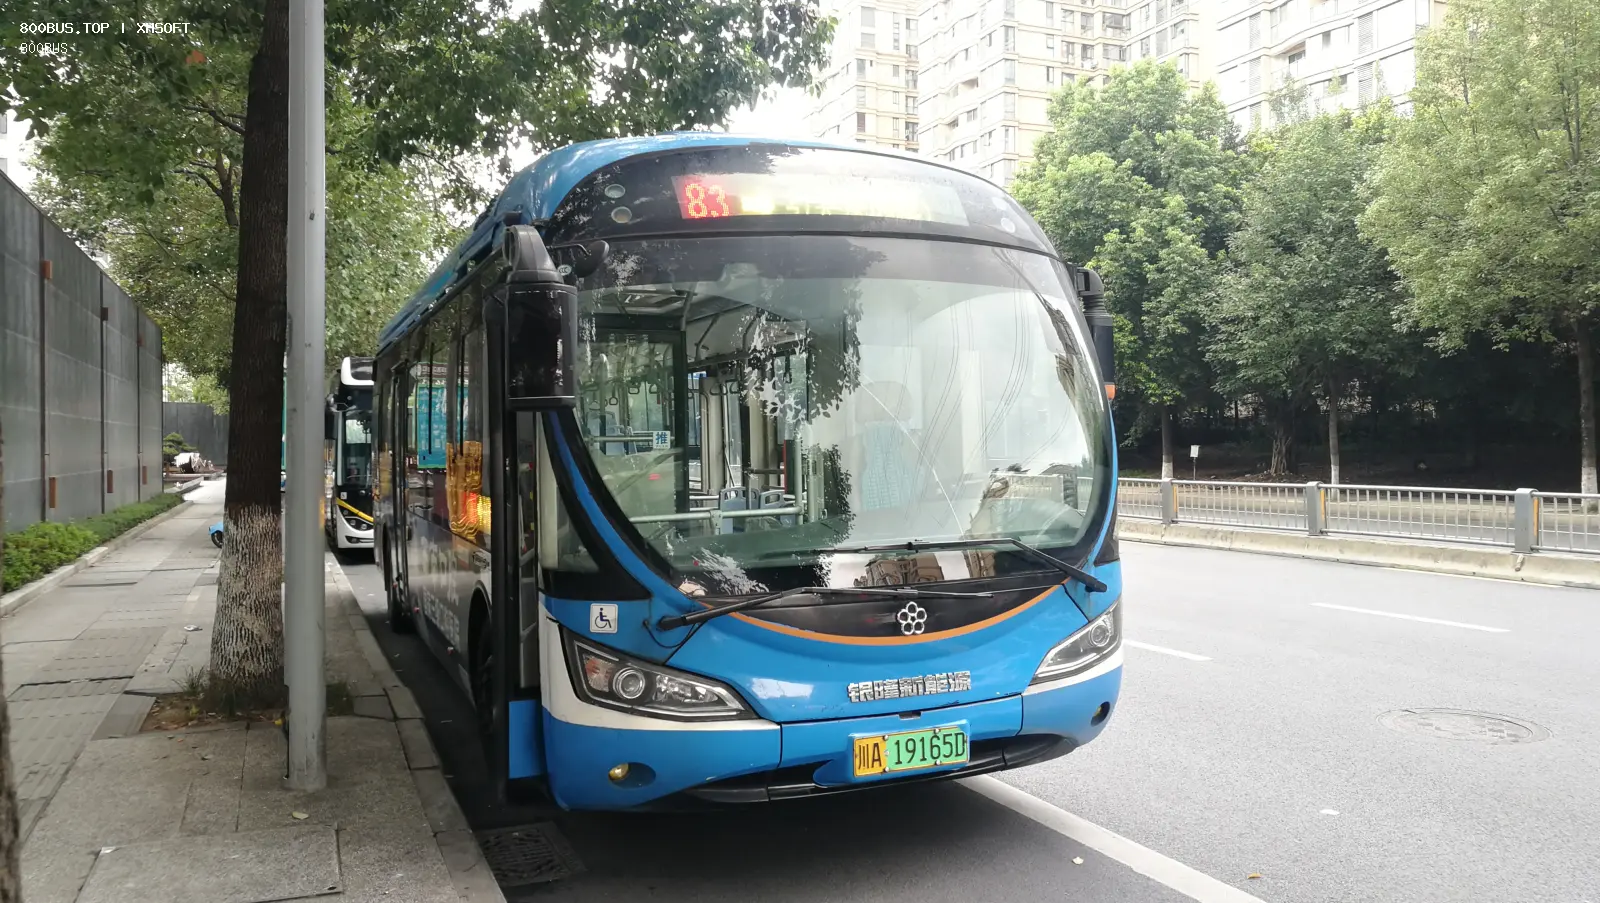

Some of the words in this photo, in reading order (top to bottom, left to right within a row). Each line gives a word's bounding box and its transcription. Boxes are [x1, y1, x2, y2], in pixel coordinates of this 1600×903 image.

[686, 183, 729, 218] 83
[655, 431, 669, 445] 推
[847, 670, 971, 703] 银隆新能源
